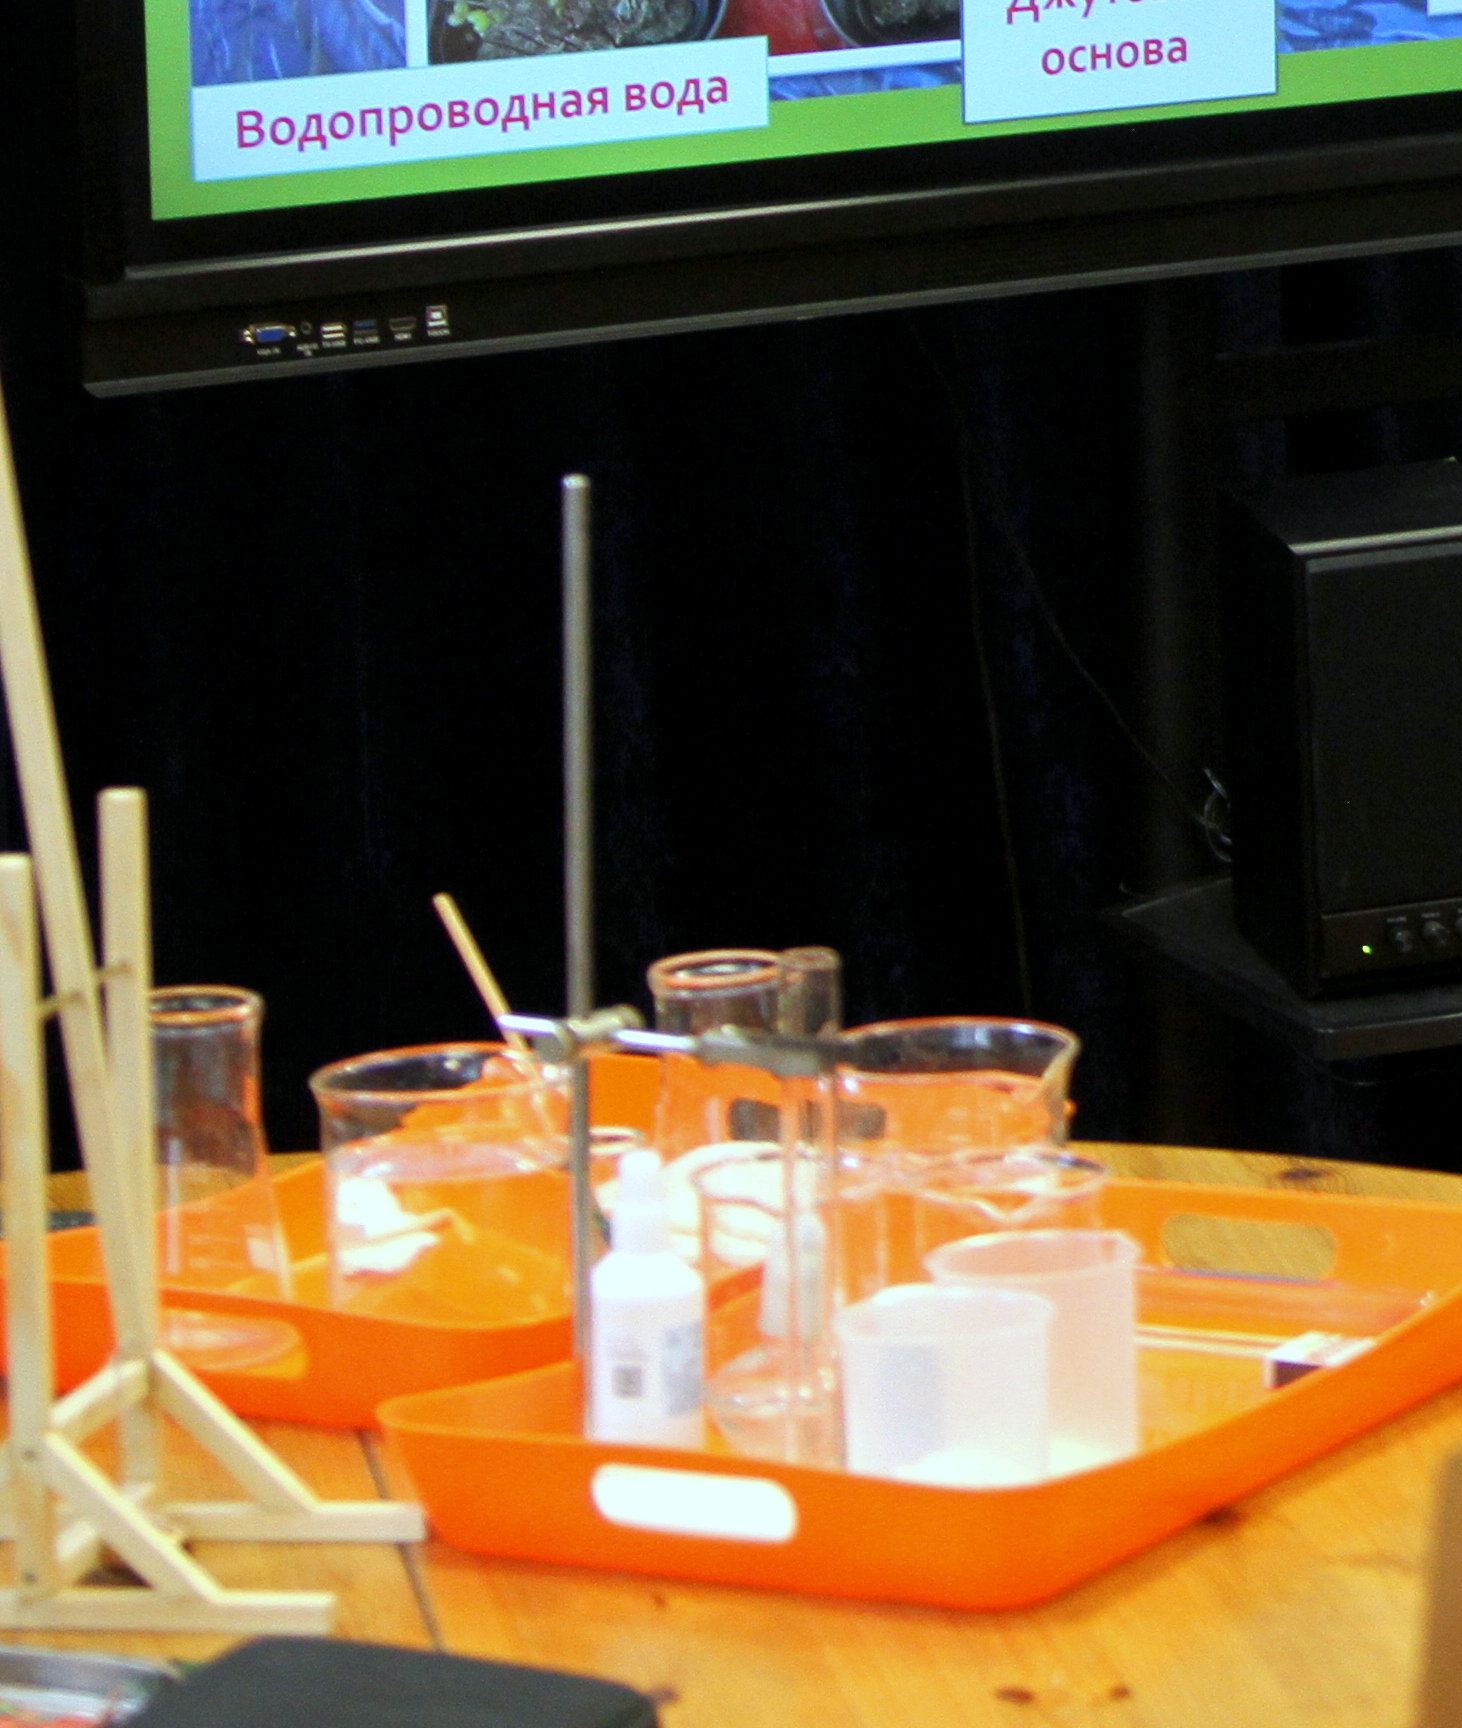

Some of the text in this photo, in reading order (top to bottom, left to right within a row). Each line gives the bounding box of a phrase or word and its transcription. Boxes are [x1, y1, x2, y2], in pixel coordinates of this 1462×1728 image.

[1042, 37, 1186, 75] основа
[237, 77, 727, 152] Водопроводная вода
